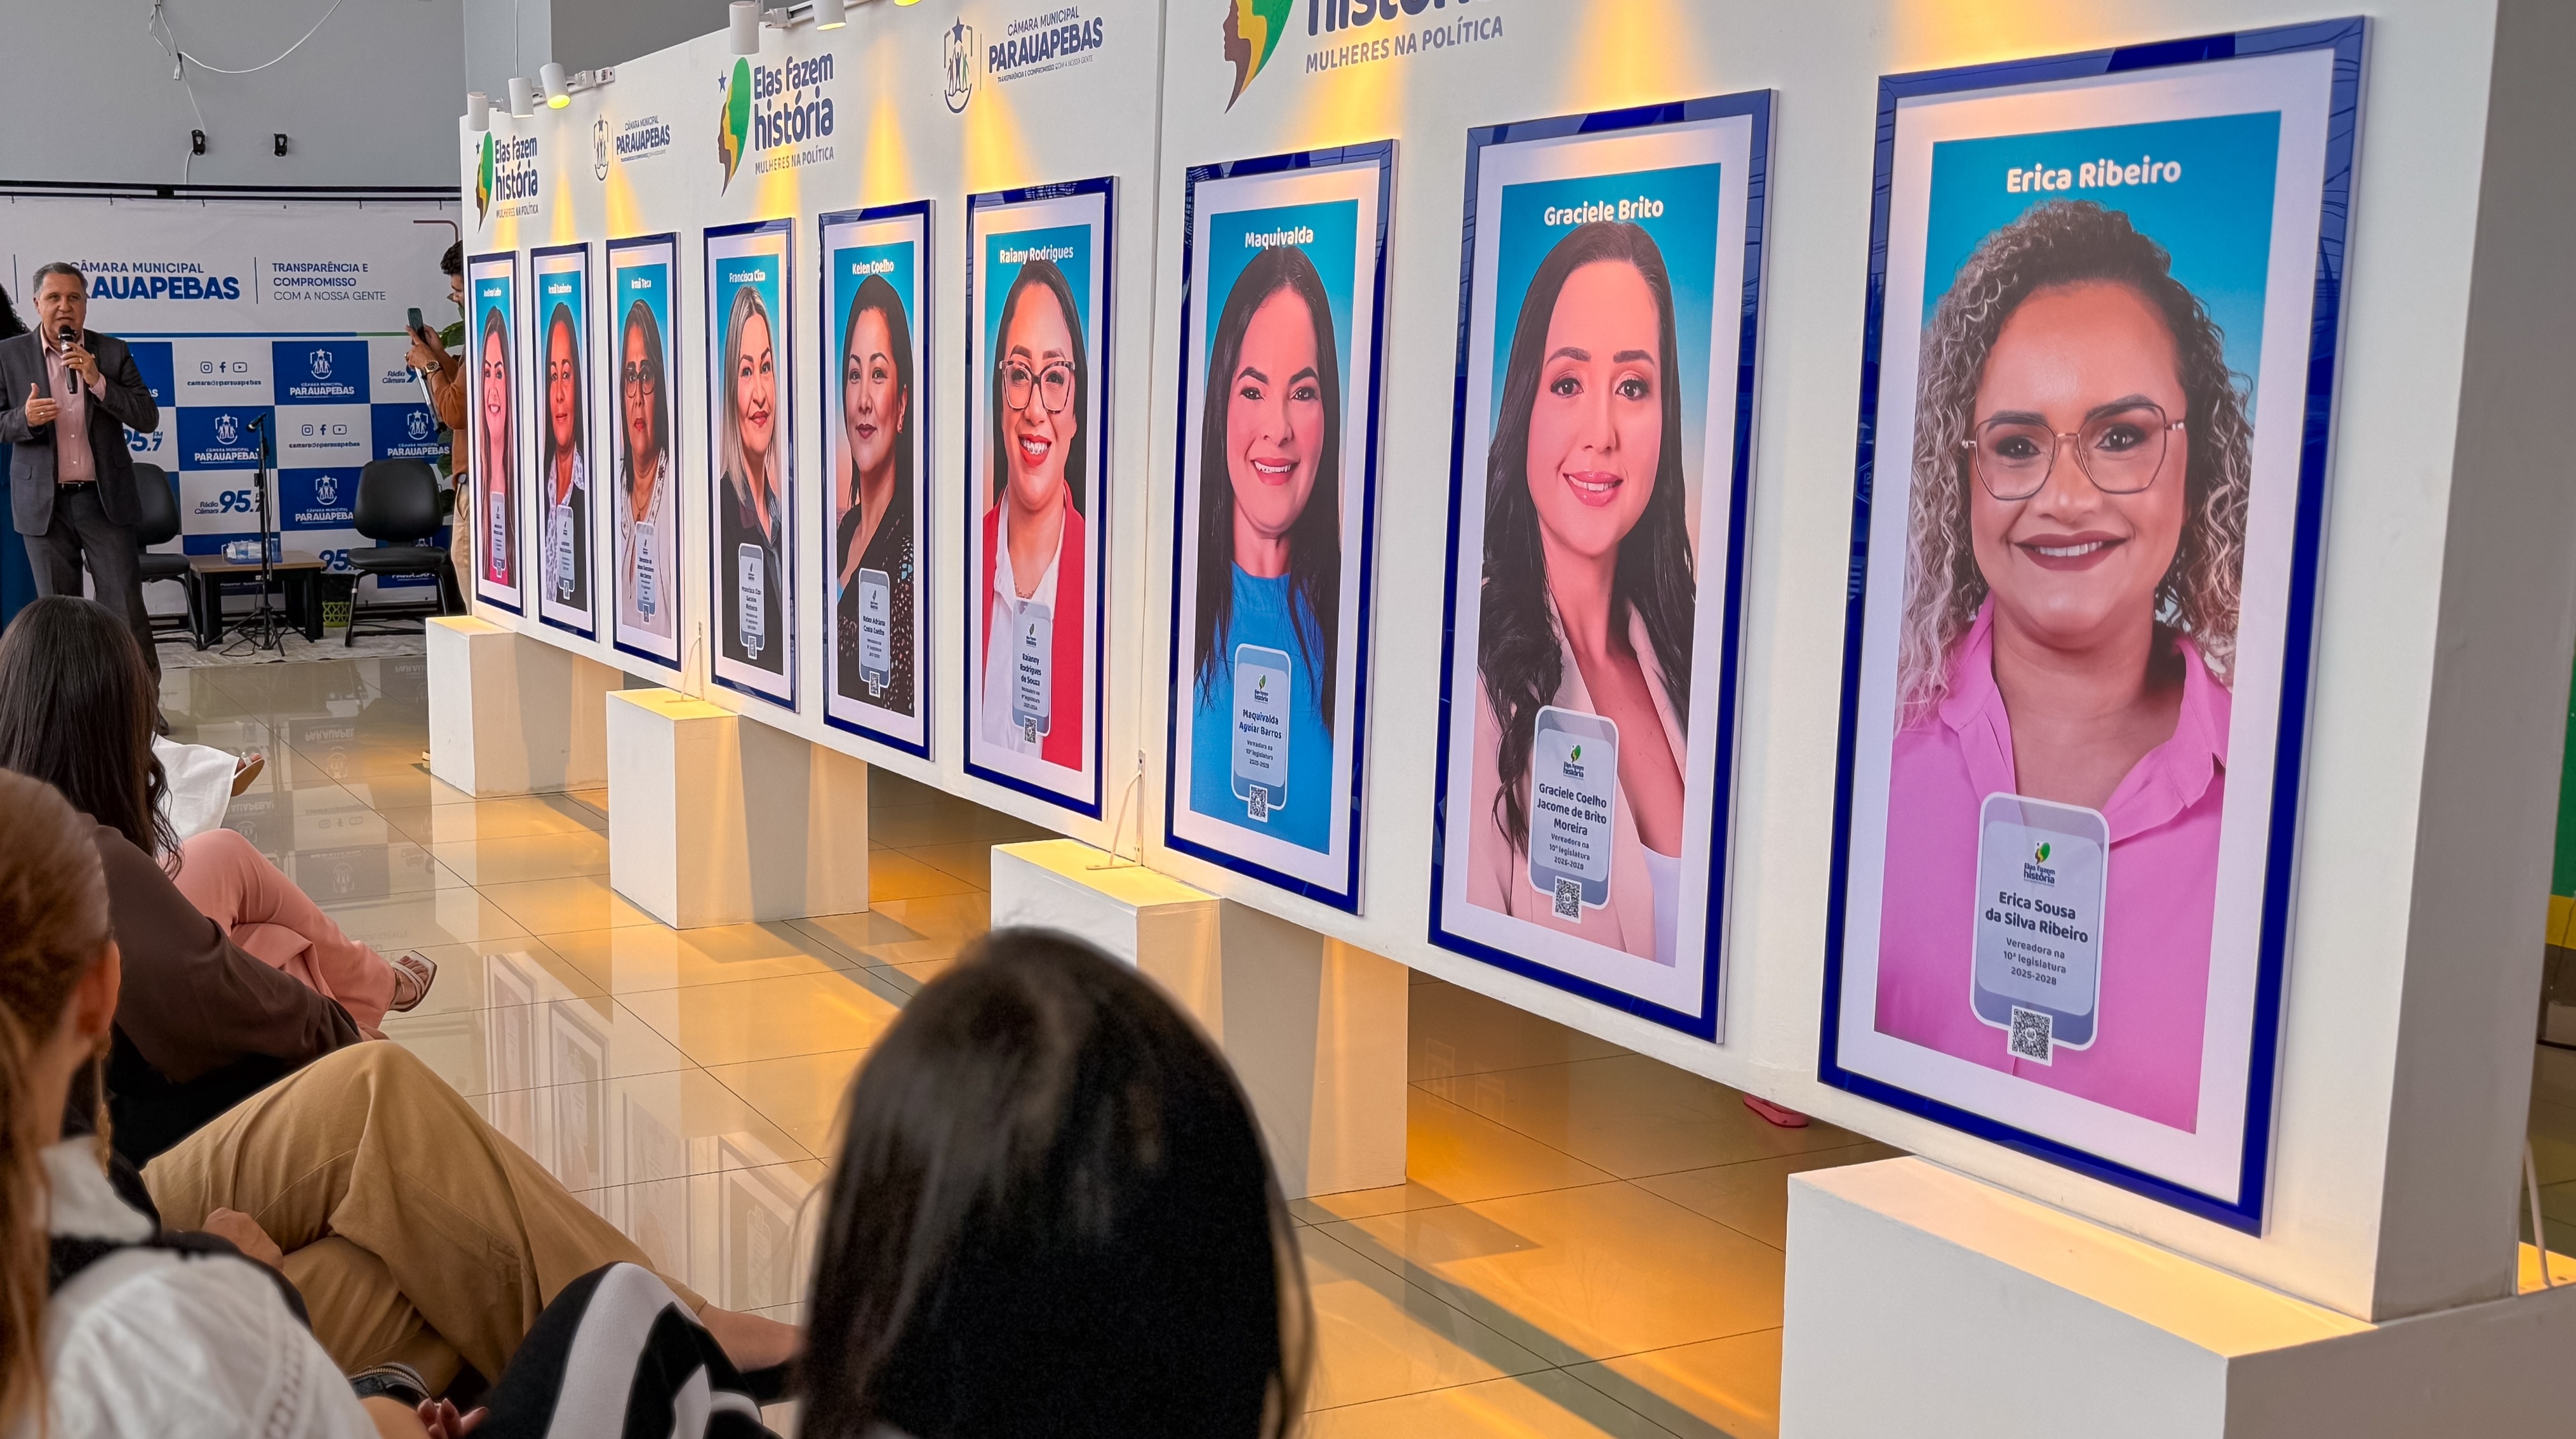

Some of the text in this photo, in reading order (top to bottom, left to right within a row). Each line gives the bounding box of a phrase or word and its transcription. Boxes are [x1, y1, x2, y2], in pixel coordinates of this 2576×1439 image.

[1007, 6, 1079, 36] CÂMARA MUNICIPAL
[989, 17, 1103, 74] PARAUAPEBAS
[1305, 37, 1390, 74] MULHERES
[1394, 32, 1417, 56] NA
[1422, 15, 1504, 51] POLÍTICA
[754, 53, 834, 100] Elas fazem
[754, 85, 834, 151] história
[495, 135, 537, 164] Elas fazem
[616, 124, 671, 156] PARAUAPEBAS
[755, 145, 834, 175] MULHERES NA POLÍTICA
[495, 159, 538, 202] história
[2007, 155, 2182, 193] Erica Ribeiro
[1544, 195, 1664, 227] Graciele Brito
[1245, 226, 1314, 251] Maquivalda
[871, 258, 895, 274] Coelho
[999, 244, 1074, 265] Raiany Rodrigues
[70, 260, 204, 274] CÂMARA MUNICIPAL
[272, 261, 369, 273] TRANSPARÊNCIA E
[729, 269, 754, 283] Francisca
[88, 275, 241, 300] AUAPEBAS
[273, 277, 357, 287] COMPROMISSO
[274, 291, 386, 301] COM A NOSSA GENTE
[290, 386, 355, 396] PARAUAPEBAS
[387, 446, 450, 456] PARAUAPEBAS
[295, 512, 354, 522] PARAUAPEBA
[319, 548, 353, 571] 95.
[1243, 708, 1279, 726] Maquivalda
[1260, 726, 1283, 739] Barros
[1538, 783, 1607, 809] Graciele Coelho
[1537, 798, 1607, 825] Jacome de Brito
[1553, 818, 1588, 836] Moreira
[1558, 845, 1591, 861] legislatura
[2024, 868, 2056, 884] história
[1998, 891, 2076, 920] Erica Sousa
[1985, 907, 2089, 944] da Silva Ribeiro
[2006, 936, 2065, 959] Vereadora na
[2017, 954, 2067, 974] legislatura
[2011, 966, 2057, 986] 2025-2028
